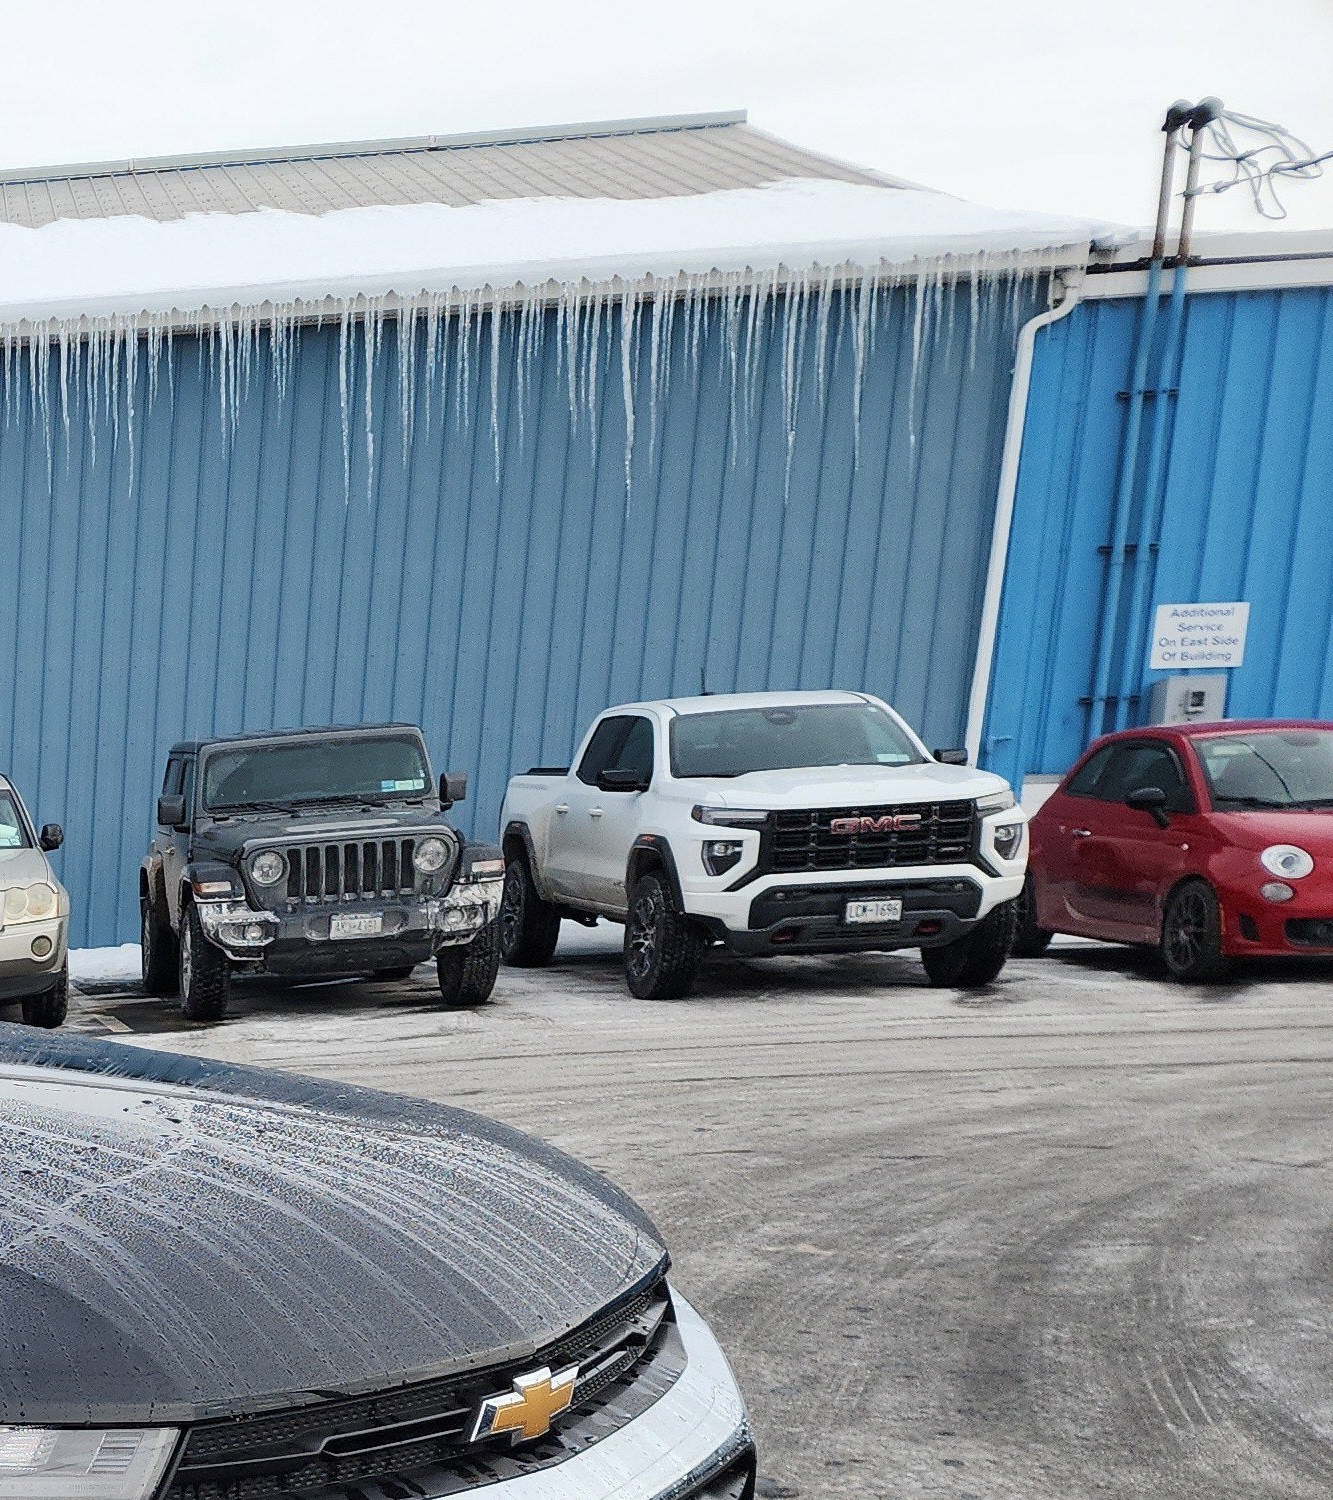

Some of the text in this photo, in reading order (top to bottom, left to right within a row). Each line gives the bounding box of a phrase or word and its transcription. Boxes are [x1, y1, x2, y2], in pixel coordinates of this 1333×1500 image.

[1171, 607, 1235, 618] Additional
[1177, 622, 1224, 632] Service
[1158, 637, 1176, 647] On
[1180, 636, 1208, 646] East
[1180, 650, 1232, 662] Building
[830, 814, 922, 835] GMC
